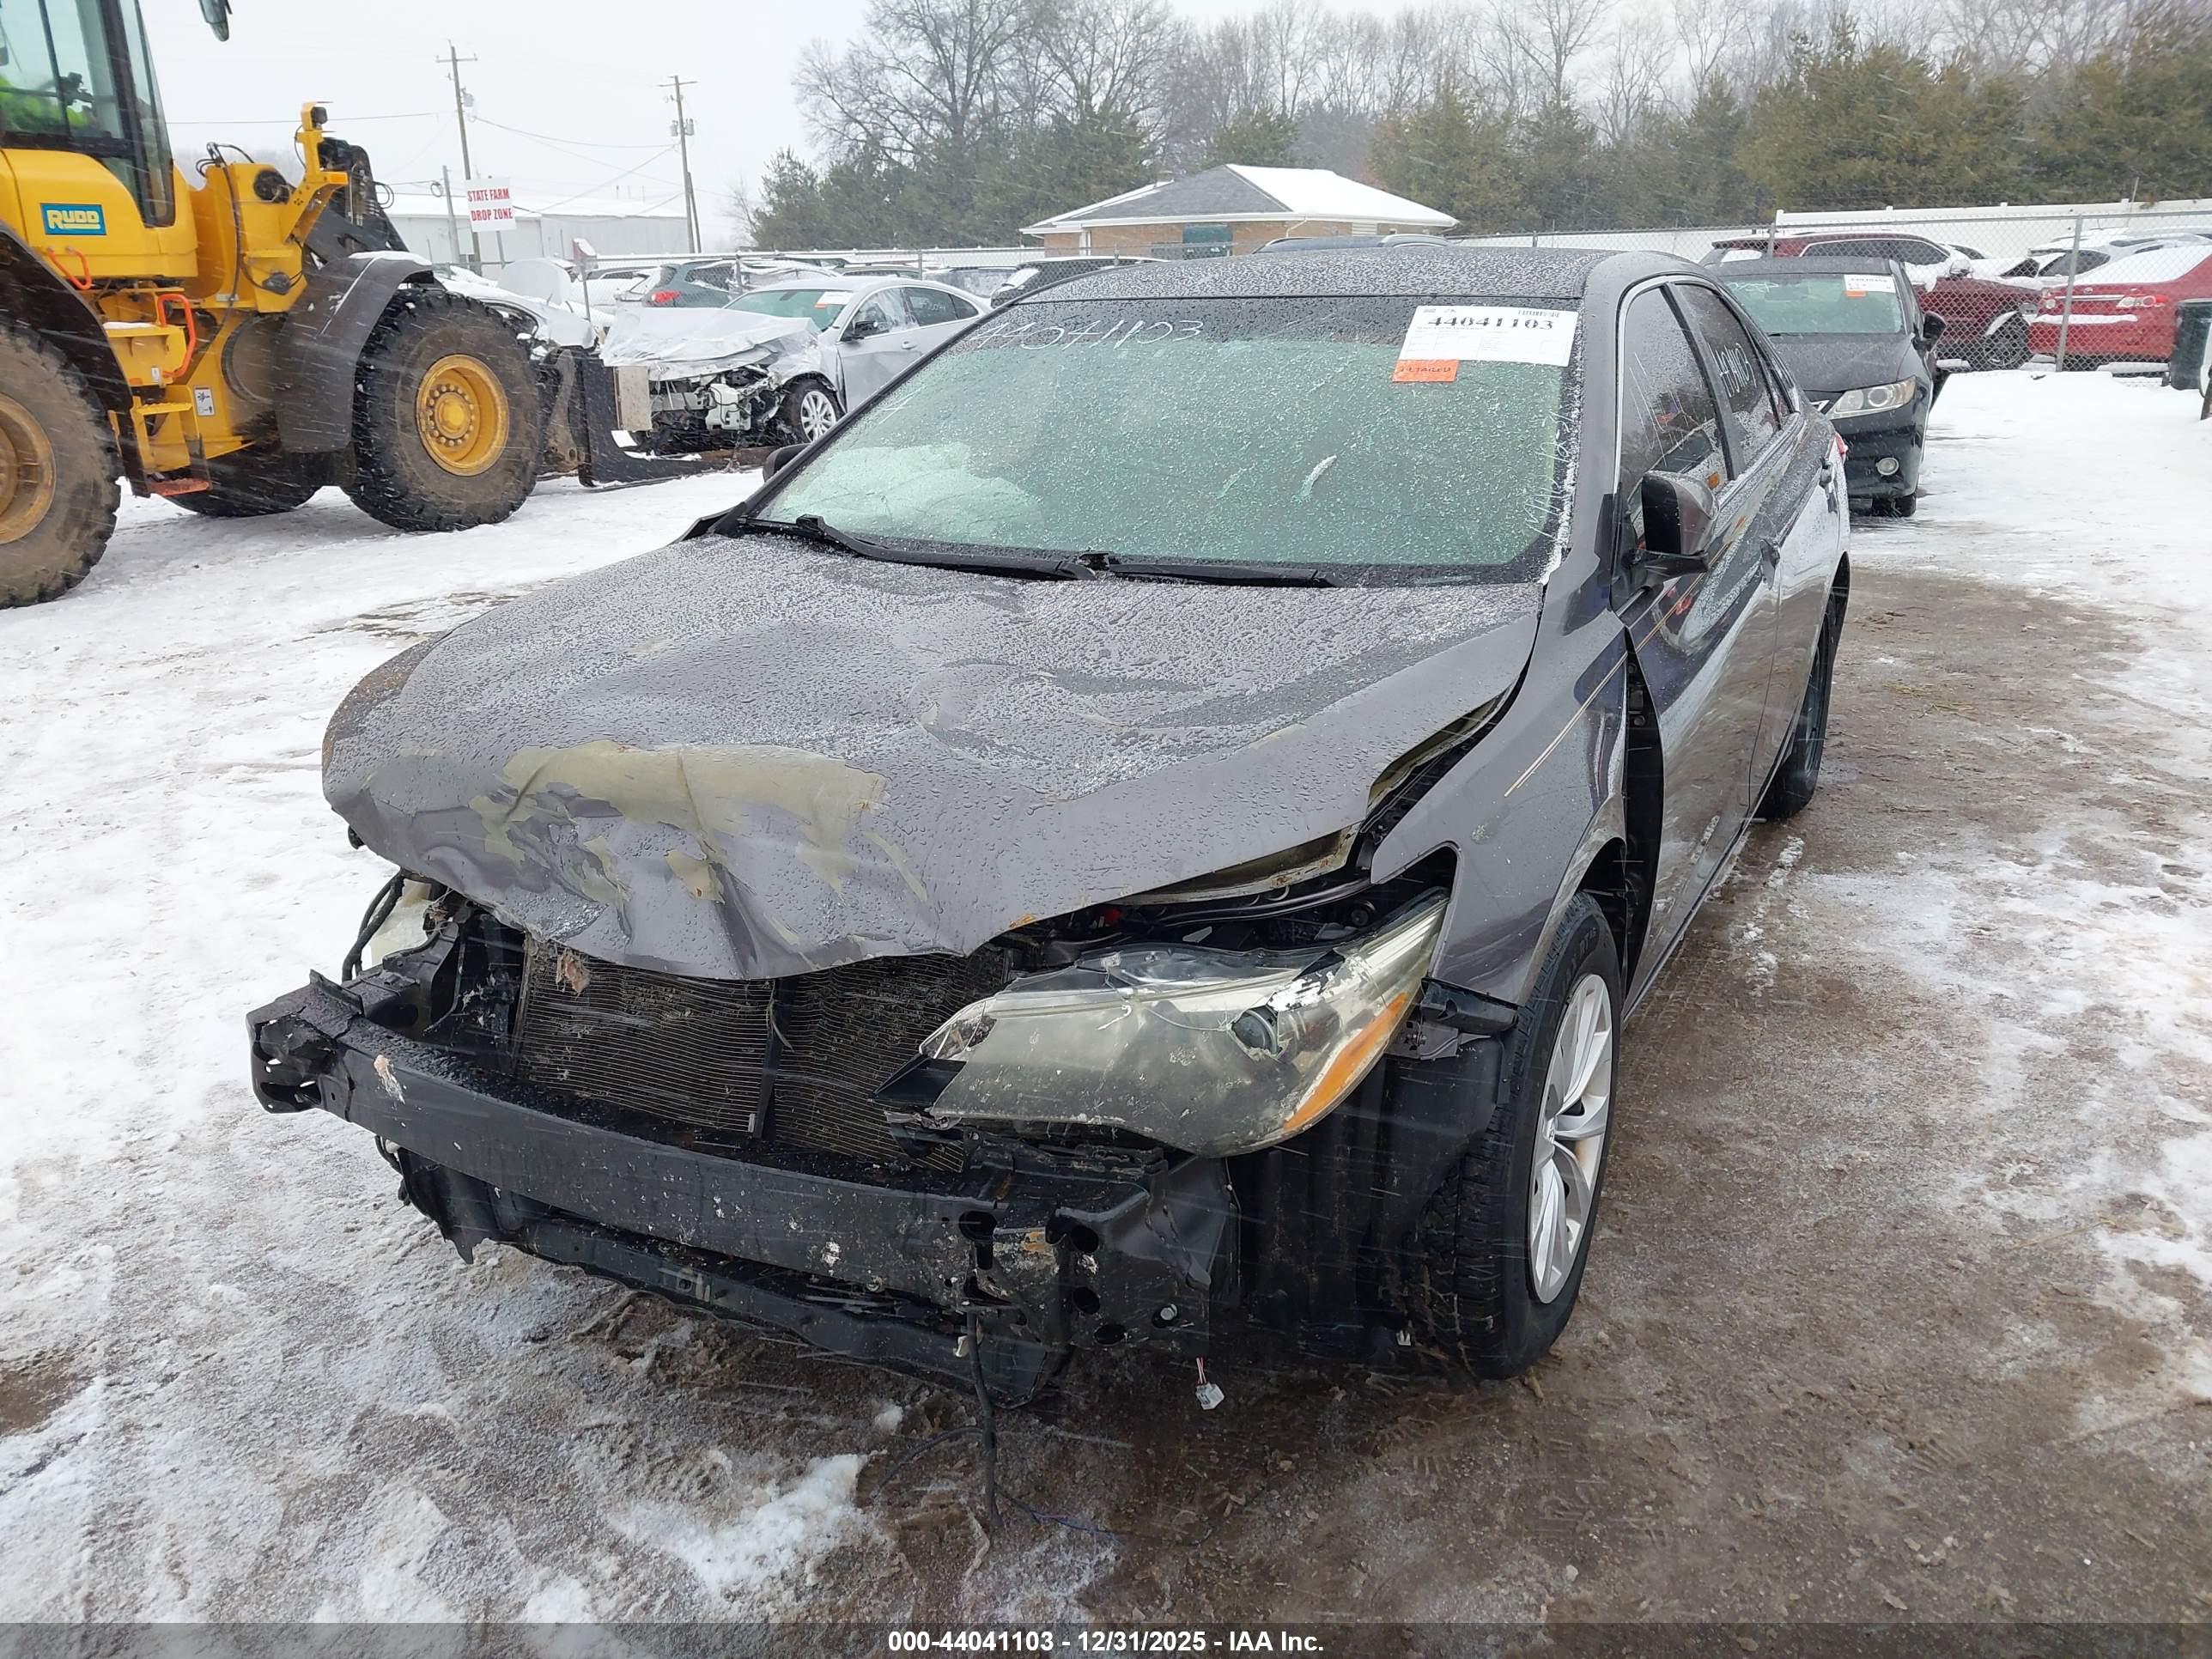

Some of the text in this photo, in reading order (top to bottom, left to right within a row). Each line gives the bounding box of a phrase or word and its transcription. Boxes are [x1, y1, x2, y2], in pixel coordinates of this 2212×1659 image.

[467, 188, 509, 202] STATE FARM
[46, 210, 100, 229] RUDD
[471, 208, 513, 221] DROP ZONE
[1428, 315, 1554, 331] 44041103
